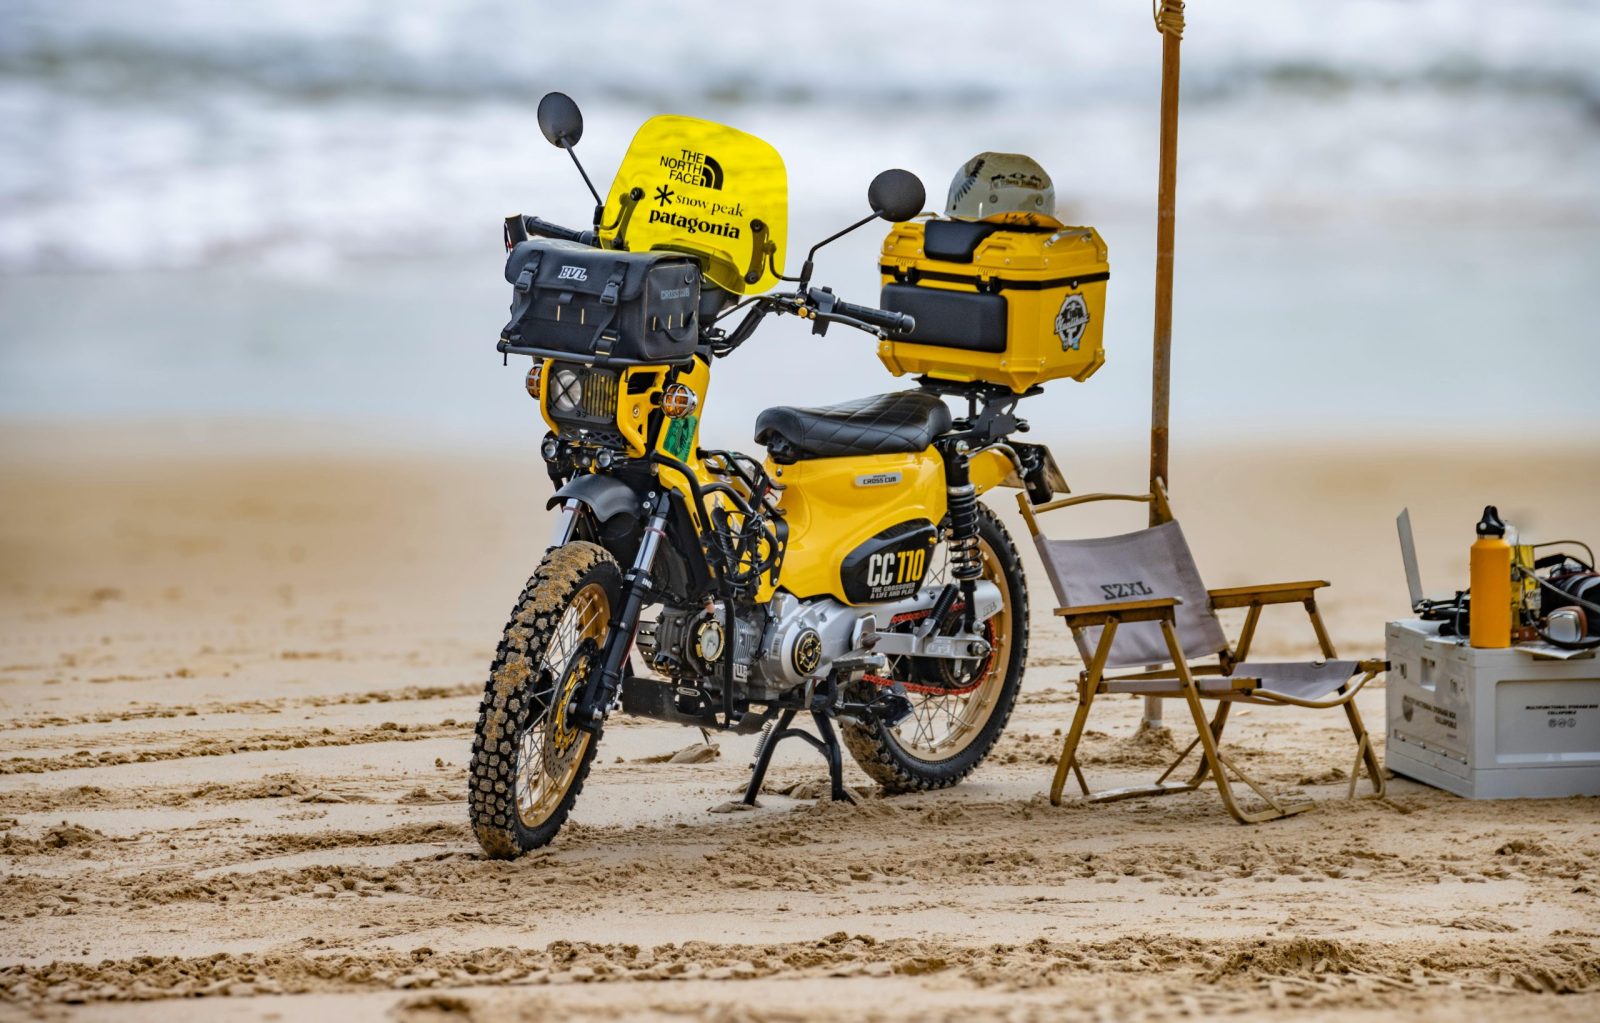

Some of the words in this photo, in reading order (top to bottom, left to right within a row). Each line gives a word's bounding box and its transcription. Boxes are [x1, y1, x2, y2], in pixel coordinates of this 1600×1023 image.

[660, 155, 702, 175] NORTH
[681, 149, 704, 164] THE
[669, 170, 700, 186] FACE
[675, 195, 709, 209] snow
[711, 202, 744, 217] peak
[649, 209, 740, 239] patagonia
[867, 552, 895, 587] CC
[876, 591, 888, 599] LIFE
[884, 582, 916, 592] CROSSOVER
